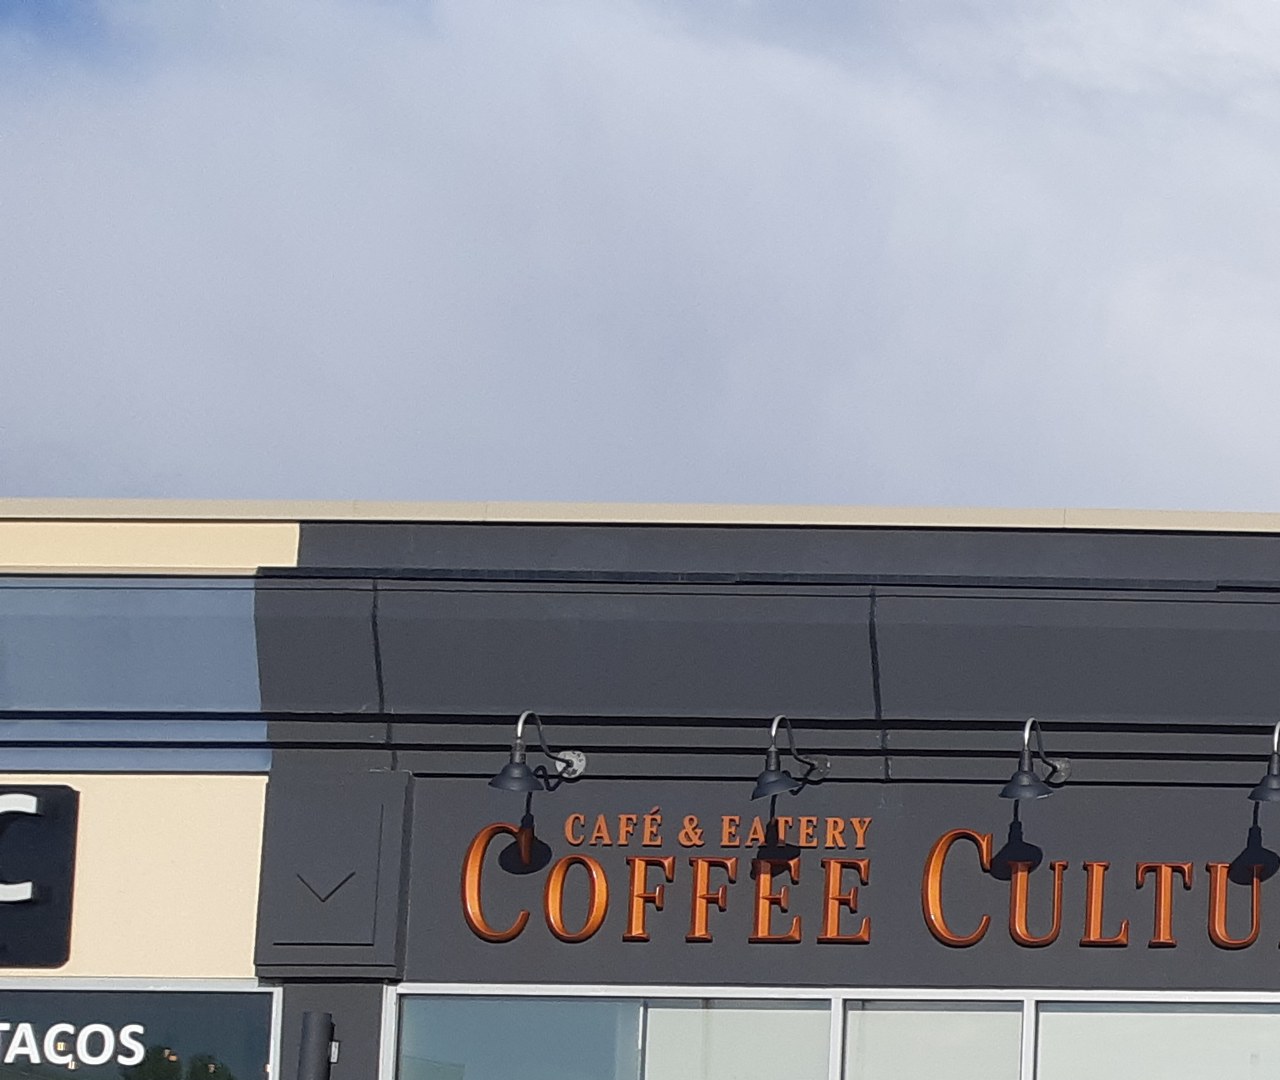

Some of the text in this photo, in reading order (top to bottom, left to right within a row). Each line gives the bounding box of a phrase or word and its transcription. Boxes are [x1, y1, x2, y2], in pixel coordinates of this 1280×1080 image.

[564, 806, 872, 848] CAFÉ & EATERY
[460, 821, 871, 944] COFFEE
